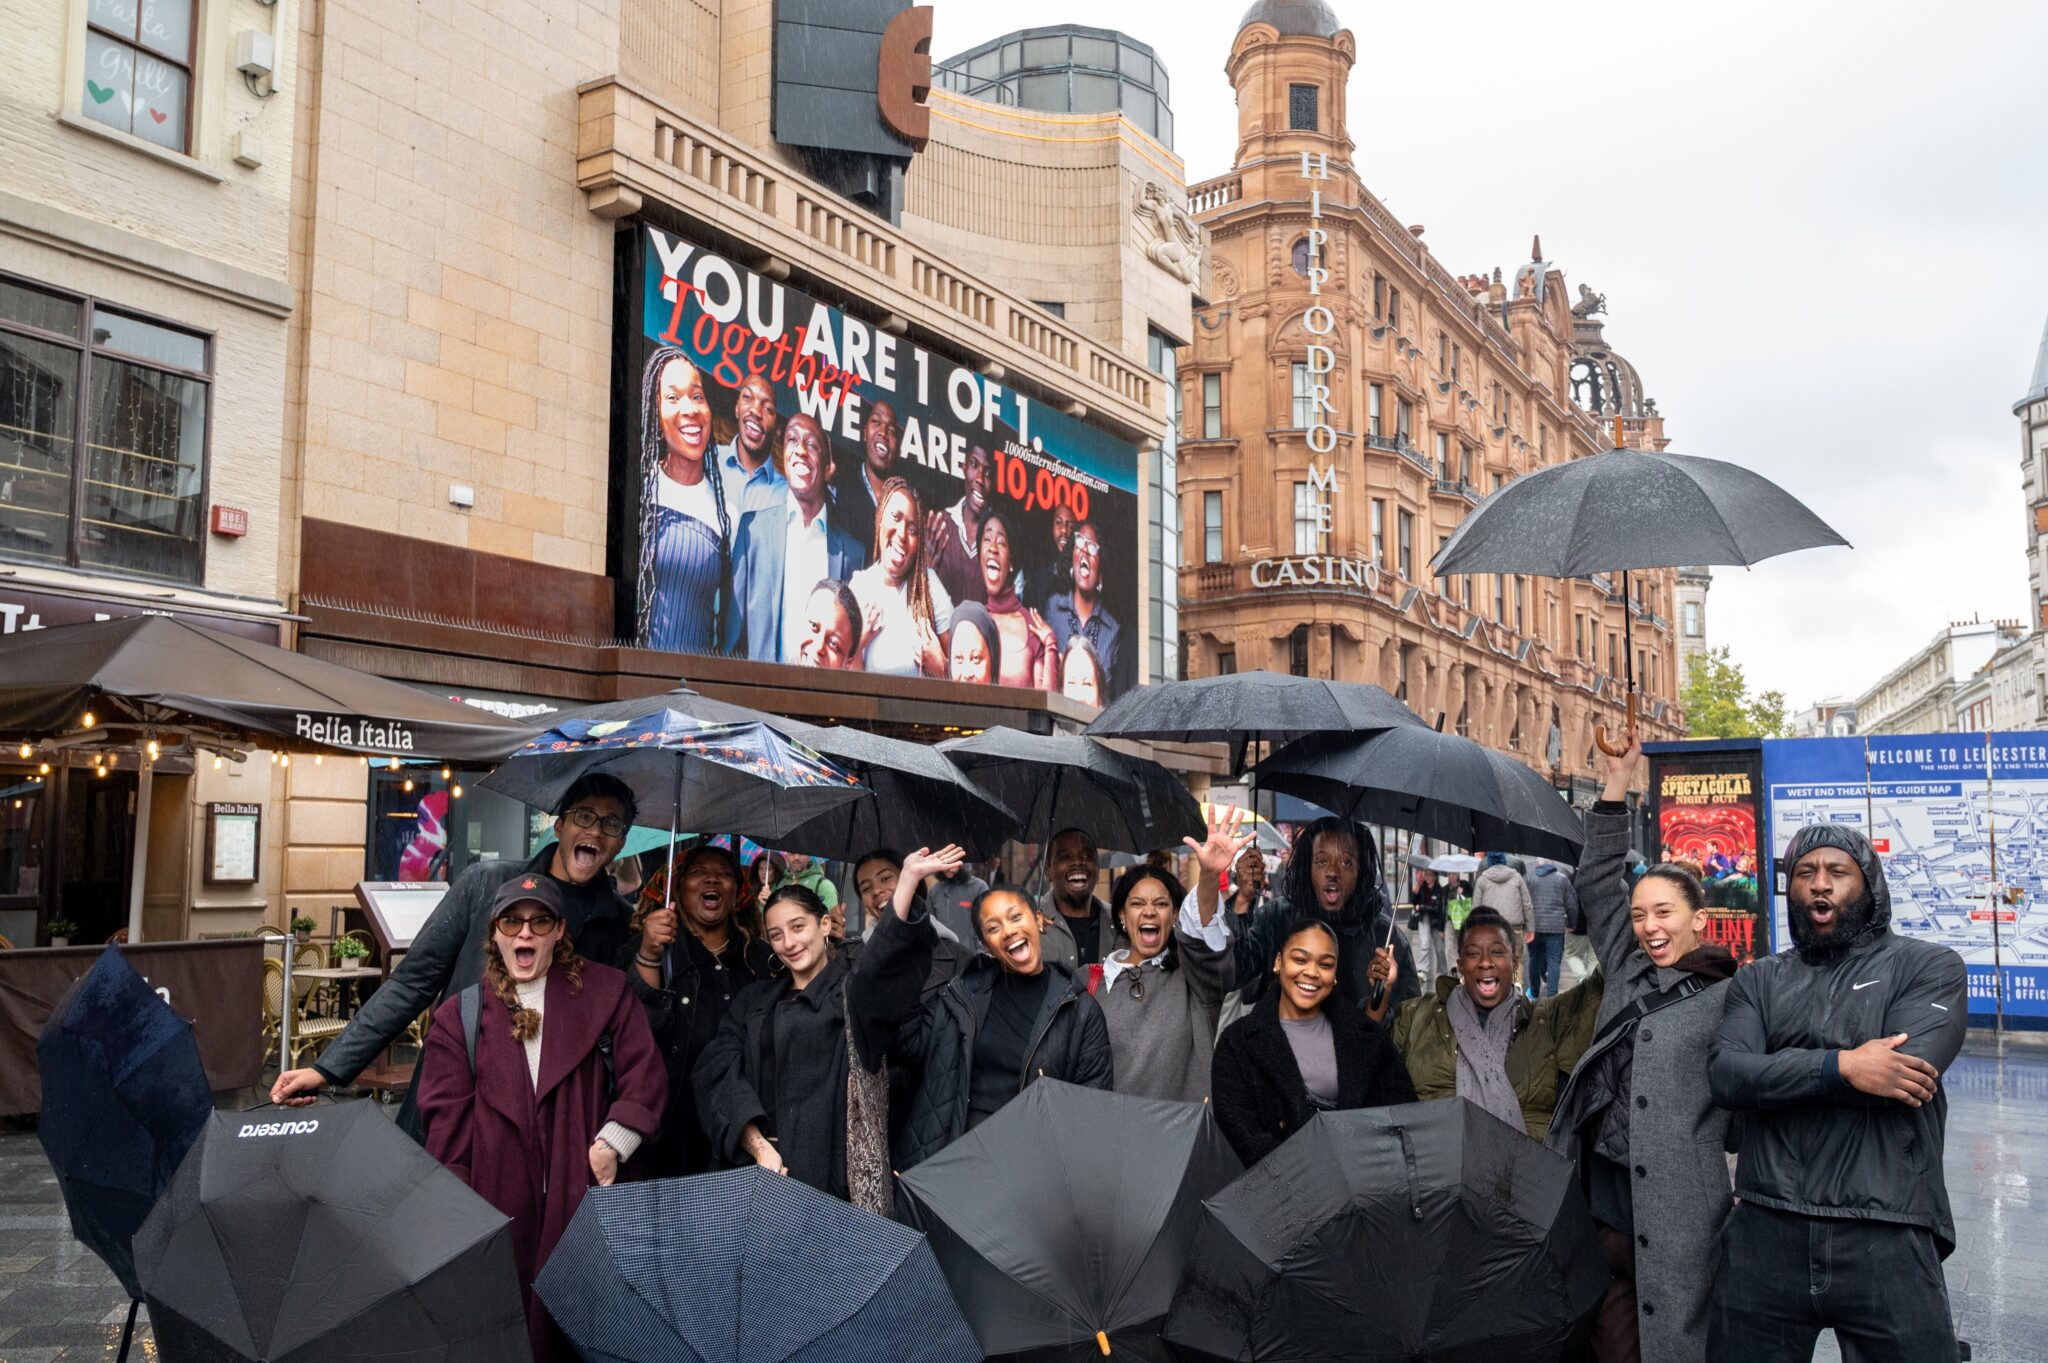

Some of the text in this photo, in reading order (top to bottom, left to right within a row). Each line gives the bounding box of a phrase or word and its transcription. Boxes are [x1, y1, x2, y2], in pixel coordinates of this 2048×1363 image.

[648, 227, 784, 342] YOU
[801, 302, 896, 393] ARE
[914, 347, 929, 406] 1
[948, 368, 1002, 432] OF
[658, 274, 862, 408] Together
[1299, 151, 1340, 533] HIPPODROME
[796, 372, 1089, 522] WE ARE 10,000
[1004, 440, 1109, 494] 10000internsfoundation.com
[1250, 555, 1379, 591] CASINO
[296, 714, 414, 750] Bella Italia
[1865, 747, 2047, 765] WELCOME TO LEICESTER
[1661, 779, 1752, 796] SPECTACULAR
[1787, 788, 1813, 797] WEST
[1815, 788, 1835, 796] END
[1837, 786, 1888, 795] THEATRES
[1896, 786, 1926, 795] GUIDE
[1928, 785, 1952, 794] MAP
[1676, 794, 1738, 804] NIGHT OUT!
[214, 803, 259, 814] Bella Italia
[2015, 976, 2035, 988] BOX
[2015, 988, 2048, 1000] OFFIC
[238, 1120, 319, 1138] coursera
